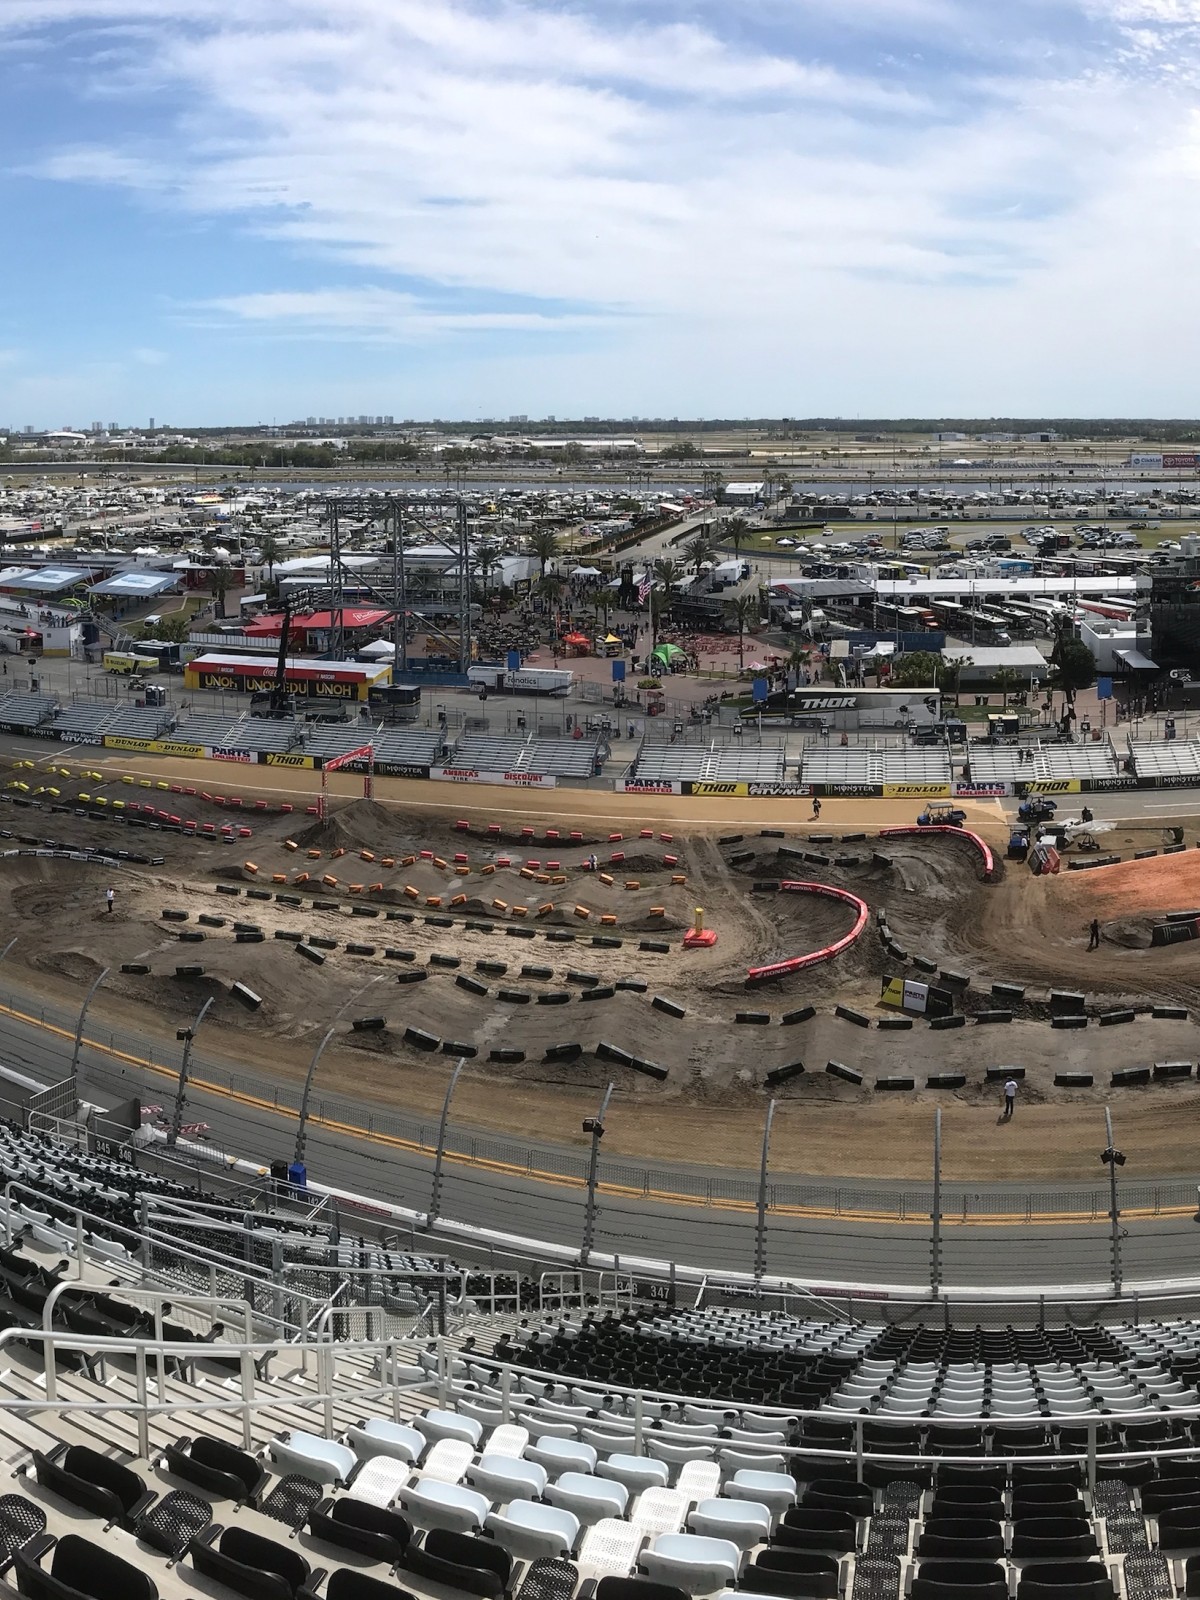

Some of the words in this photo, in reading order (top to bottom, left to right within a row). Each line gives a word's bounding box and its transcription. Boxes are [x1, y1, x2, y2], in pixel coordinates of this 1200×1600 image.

[507, 676, 537, 685] Fanatics
[316, 682, 351, 696] UNOH
[801, 696, 857, 709] THOR
[114, 738, 151, 749] DUNLOP
[163, 744, 202, 753] DUNLOP
[212, 746, 250, 758] PARTS
[212, 754, 251, 763] UNLIMITED
[275, 756, 305, 766] THOR
[387, 765, 423, 774] MONSTER
[442, 769, 480, 778] AMERICA'S
[504, 773, 543, 782] DISCOUNT
[624, 780, 673, 789] PARTS
[956, 783, 1006, 791] PARTS
[1035, 781, 1069, 792] THOR
[1098, 778, 1138, 787] MONSTER
[702, 784, 738, 793] THOR
[833, 785, 875, 793] MONSTER
[805, 955, 829, 967] HONDA
[763, 967, 792, 977] HONDA
[887, 987, 902, 996] THOR
[905, 989, 925, 998] PARTS
[96, 1140, 111, 1155] 345
[287, 1190, 298, 1200] 141
[307, 1196, 319, 1206] 142
[617, 1281, 638, 1295] 346
[650, 1285, 670, 1299] 347
